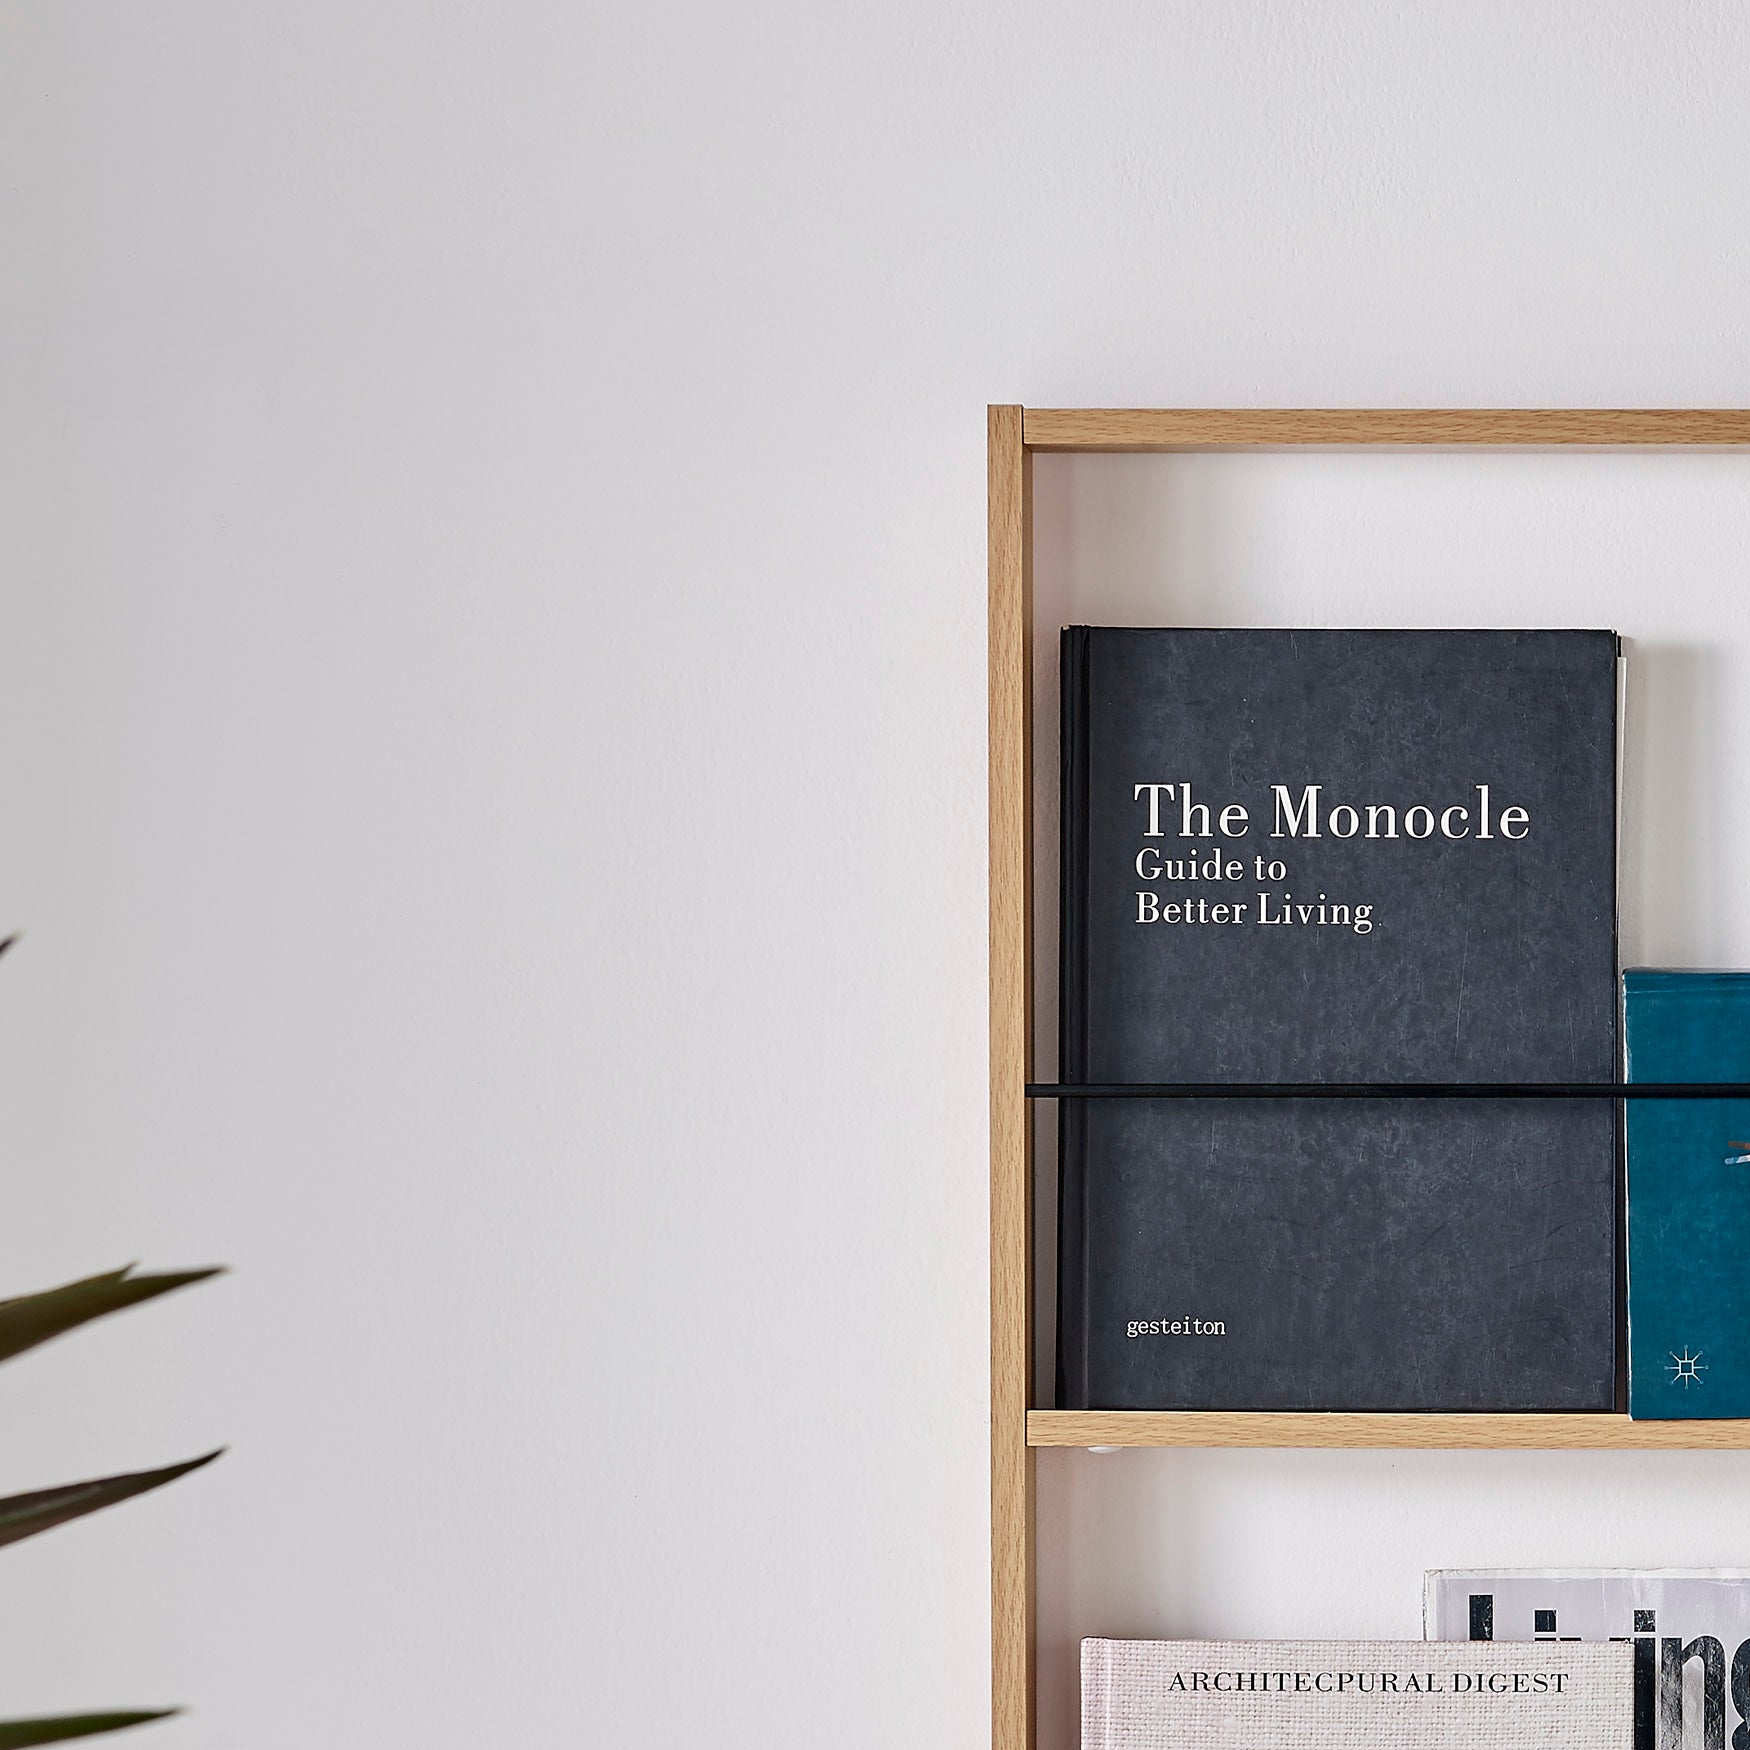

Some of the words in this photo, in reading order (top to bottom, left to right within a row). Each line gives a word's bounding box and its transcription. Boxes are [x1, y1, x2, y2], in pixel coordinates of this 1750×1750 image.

[1134, 782, 1249, 838] The
[1269, 784, 1531, 840] Monocle
[1135, 847, 1244, 882] Guide
[1253, 854, 1287, 882] to
[1134, 891, 1248, 926] Better
[1256, 892, 1374, 935] Living
[1126, 1316, 1226, 1338] gesteiton
[1168, 1671, 1443, 1693] ARCHITECPURAL
[1453, 1673, 1569, 1694] DIGEST
